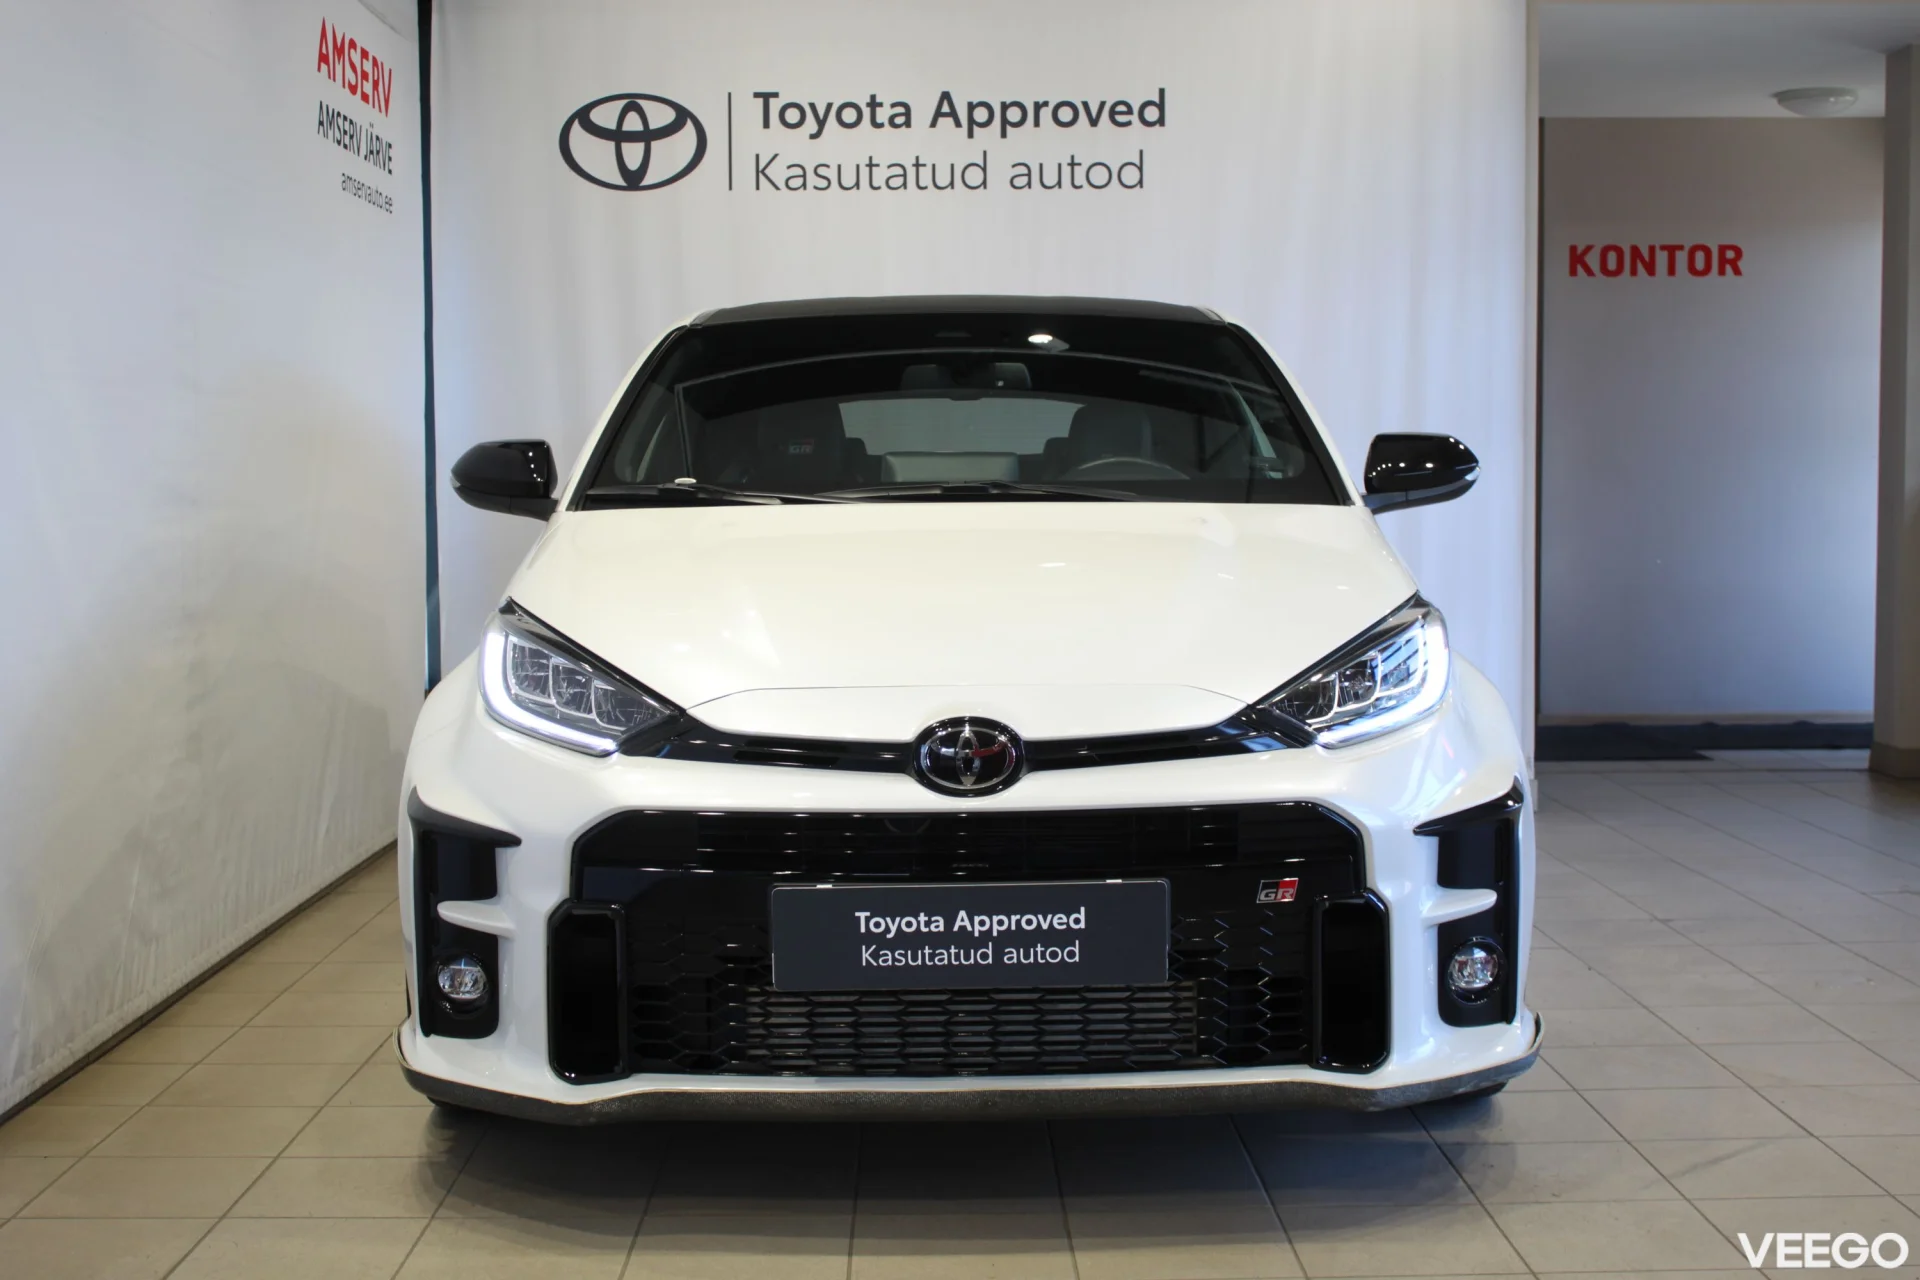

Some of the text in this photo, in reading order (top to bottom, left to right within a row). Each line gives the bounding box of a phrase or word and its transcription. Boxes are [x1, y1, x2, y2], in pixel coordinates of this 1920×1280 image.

[317, 16, 392, 118] AMSERV
[752, 88, 1166, 140] Toyota Approved
[317, 100, 393, 175] AMSERV JÄRVE
[754, 149, 1144, 191] Kasutatud autod
[341, 172, 393, 214] amservauto.ee
[1568, 243, 1744, 277] KONTOR
[1259, 888, 1294, 901] GR
[855, 907, 1086, 938] Toyota Approved
[861, 940, 1080, 967] Kasutatud autod
